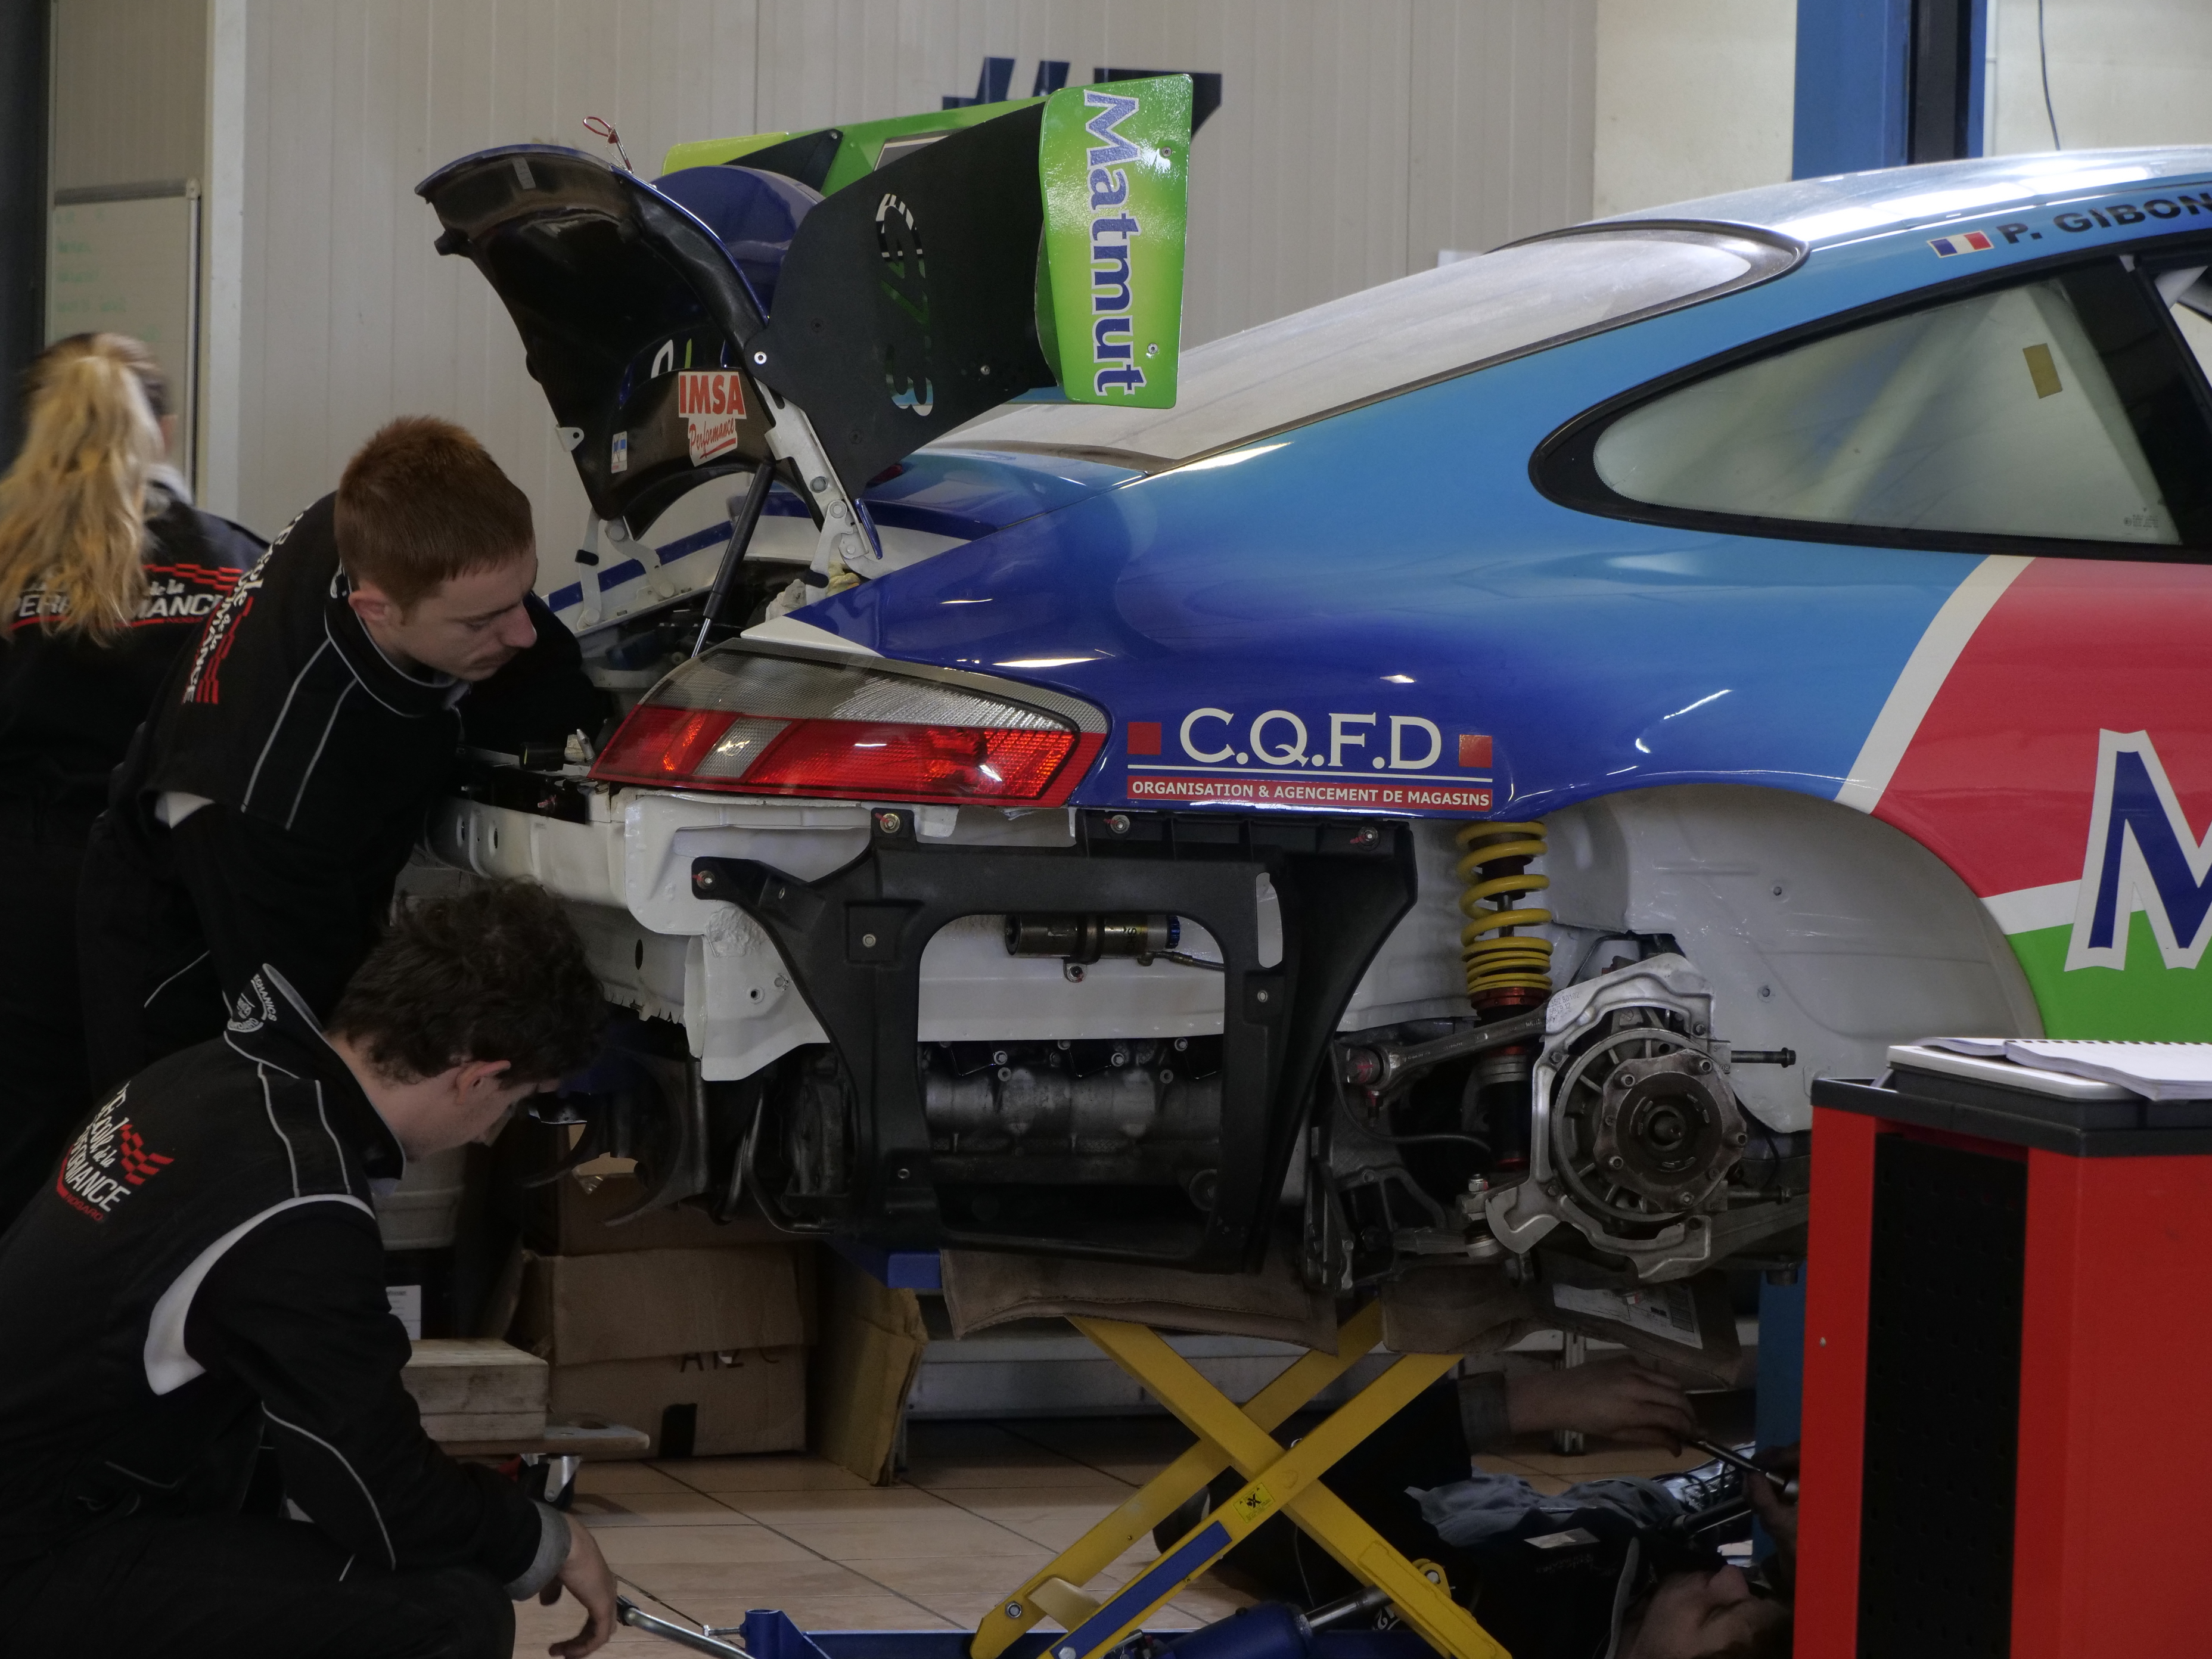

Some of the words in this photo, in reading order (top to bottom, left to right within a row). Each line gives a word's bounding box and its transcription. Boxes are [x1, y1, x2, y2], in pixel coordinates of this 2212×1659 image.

[1083, 89, 1147, 396] Matmut
[1996, 223, 2043, 244] P.
[679, 374, 745, 415] IMSA
[689, 418, 735, 456] Performance
[1180, 707, 1442, 769] C.Q.F.D
[1132, 781, 1253, 797] ORGANISATION
[1258, 785, 1267, 798] &
[1273, 785, 1379, 802] AGENCEMENT
[1383, 790, 1403, 803] DE
[1407, 791, 1490, 807] MAGASINS
[253, 973, 277, 1021] ECHANICS
